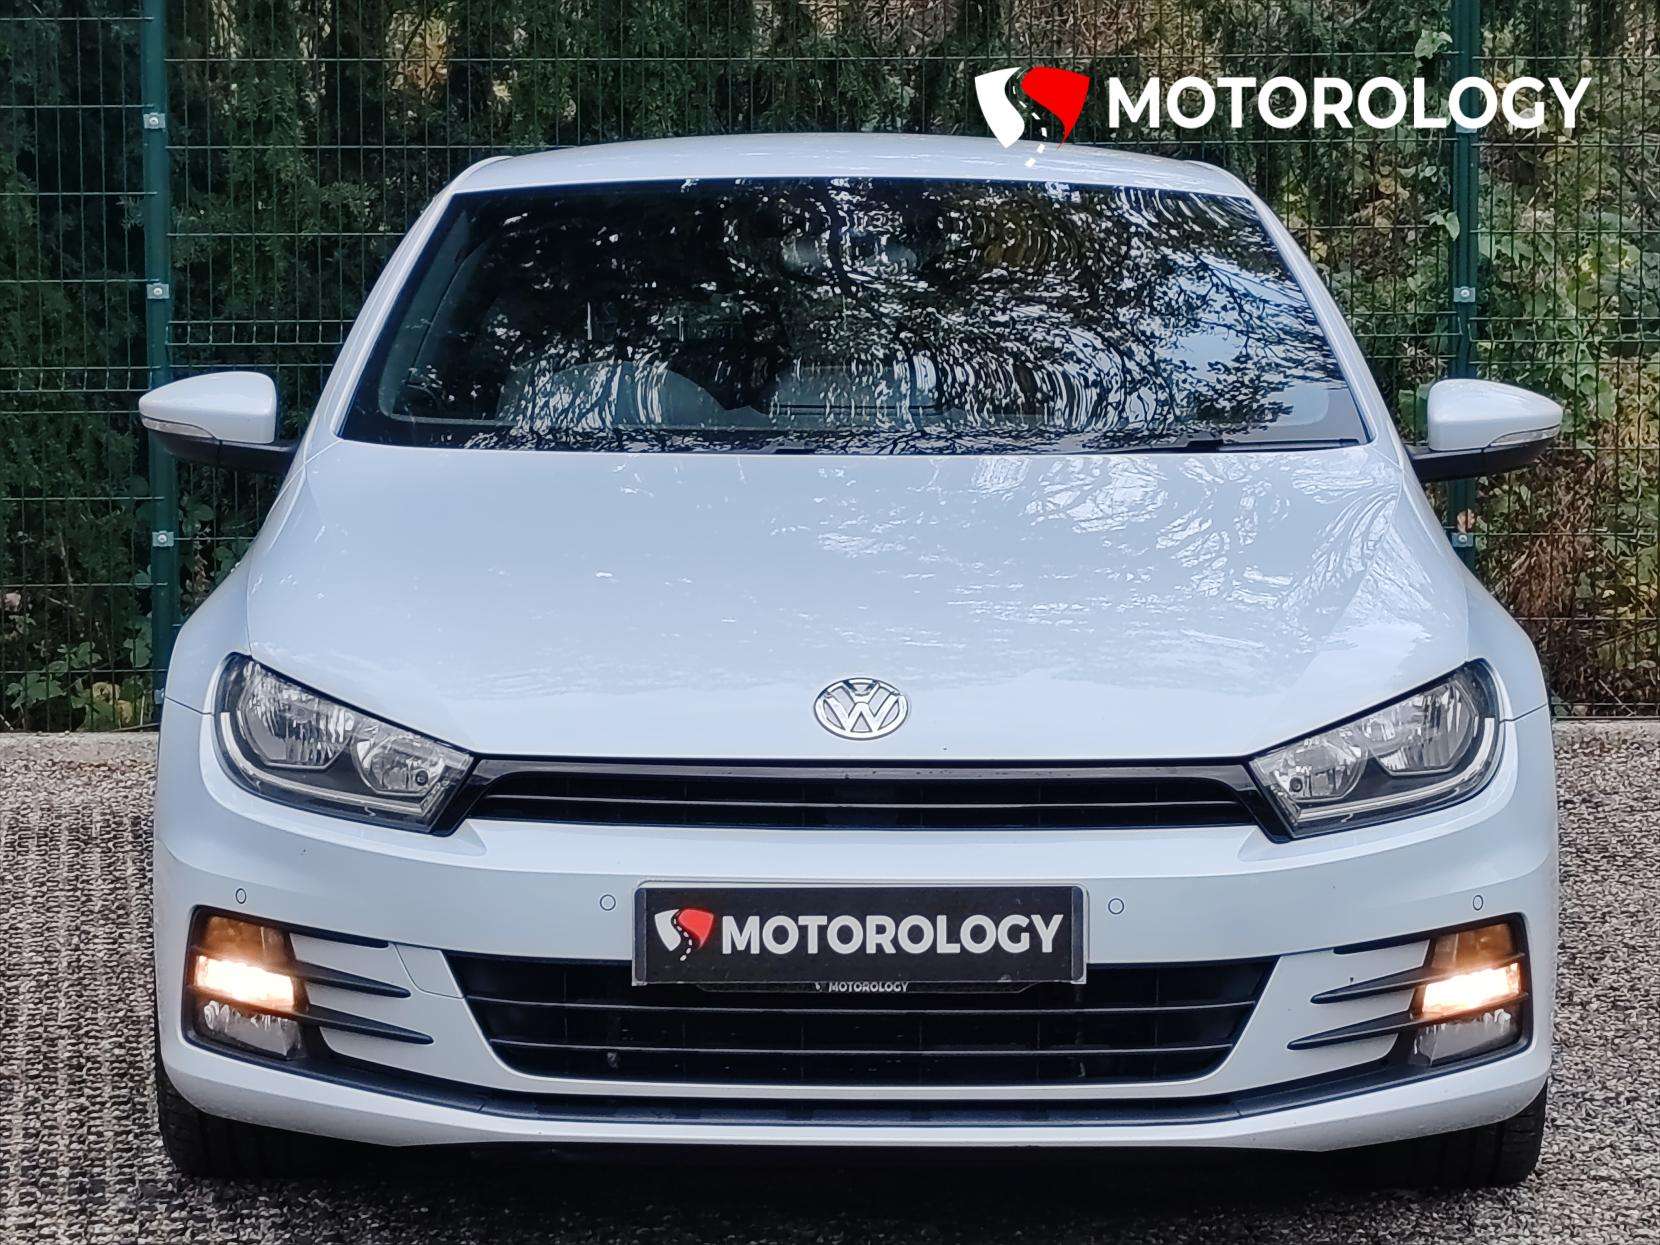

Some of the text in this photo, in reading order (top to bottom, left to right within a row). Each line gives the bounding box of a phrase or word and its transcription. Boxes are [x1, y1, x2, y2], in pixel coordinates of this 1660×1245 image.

[815, 678, 908, 740] VW
[721, 914, 1064, 955] MOTOROLOGY
[828, 981, 910, 993] MOTOROLOGY
